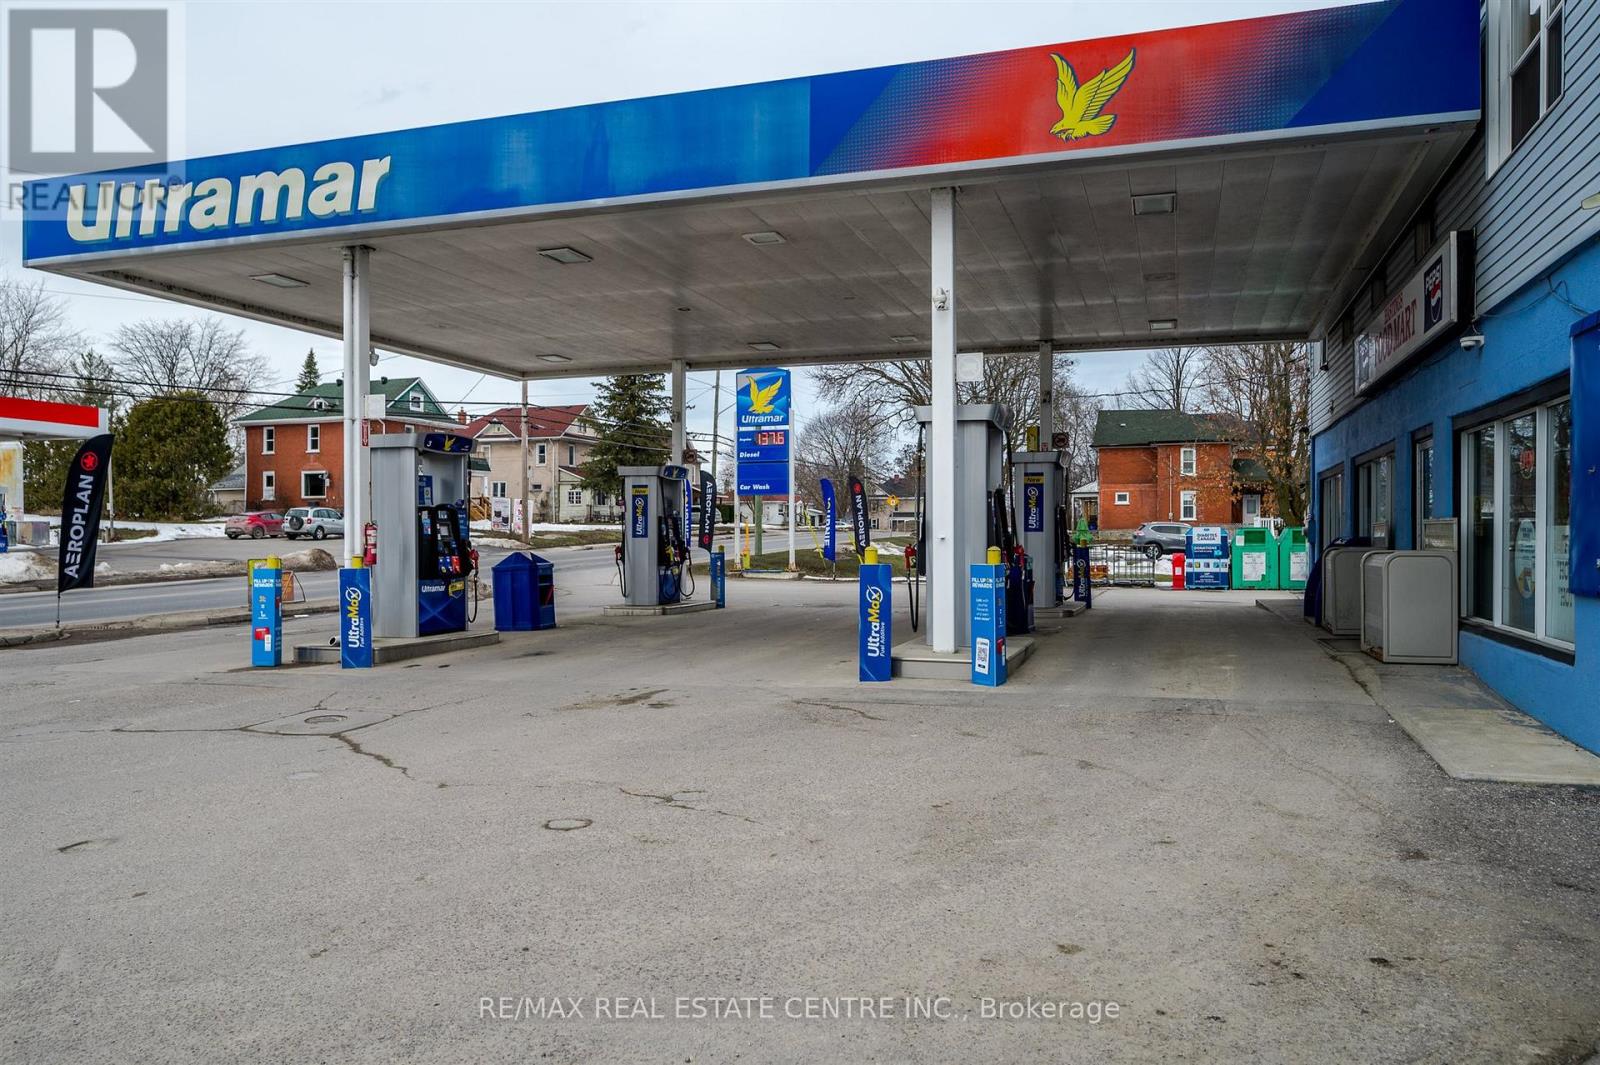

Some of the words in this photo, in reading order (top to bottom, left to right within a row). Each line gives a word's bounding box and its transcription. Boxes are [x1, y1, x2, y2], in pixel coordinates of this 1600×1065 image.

[66, 155, 391, 242] Ultramar
[426, 440, 433, 448] 3
[741, 414, 784, 424] Ultramar
[758, 431, 785, 445] 137.6
[64, 474, 94, 579] AEROPLAN
[704, 480, 713, 534] AEROPLAN
[855, 494, 867, 547] AEROPLAN
[1027, 487, 1039, 529] UltraMax
[421, 585, 446, 593] Ultramar
[345, 585, 362, 648] UltraMax
[866, 585, 883, 657] UltraMax
